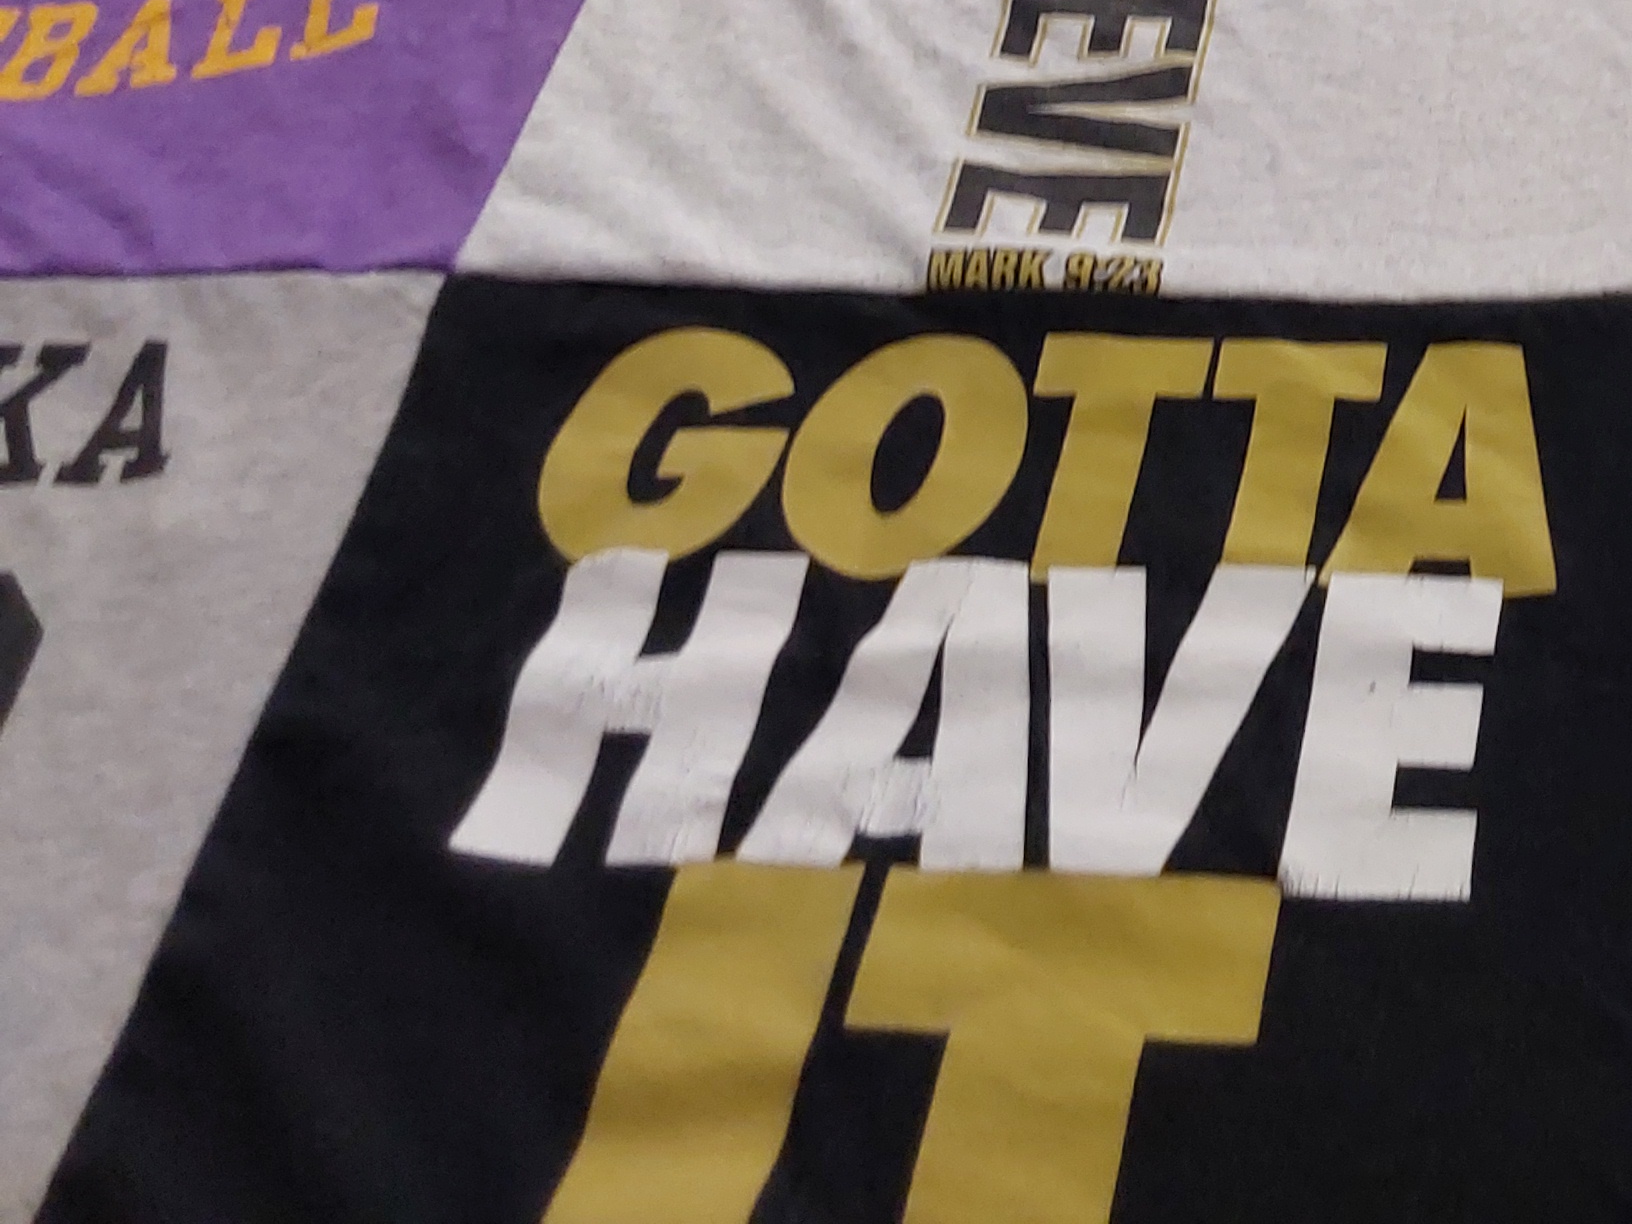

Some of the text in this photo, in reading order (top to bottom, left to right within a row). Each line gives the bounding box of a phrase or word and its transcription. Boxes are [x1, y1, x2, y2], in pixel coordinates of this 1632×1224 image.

[927, 246, 1053, 295] MARK
[537, 325, 1558, 597] GOTTA
[447, 545, 1504, 902] HAVE
